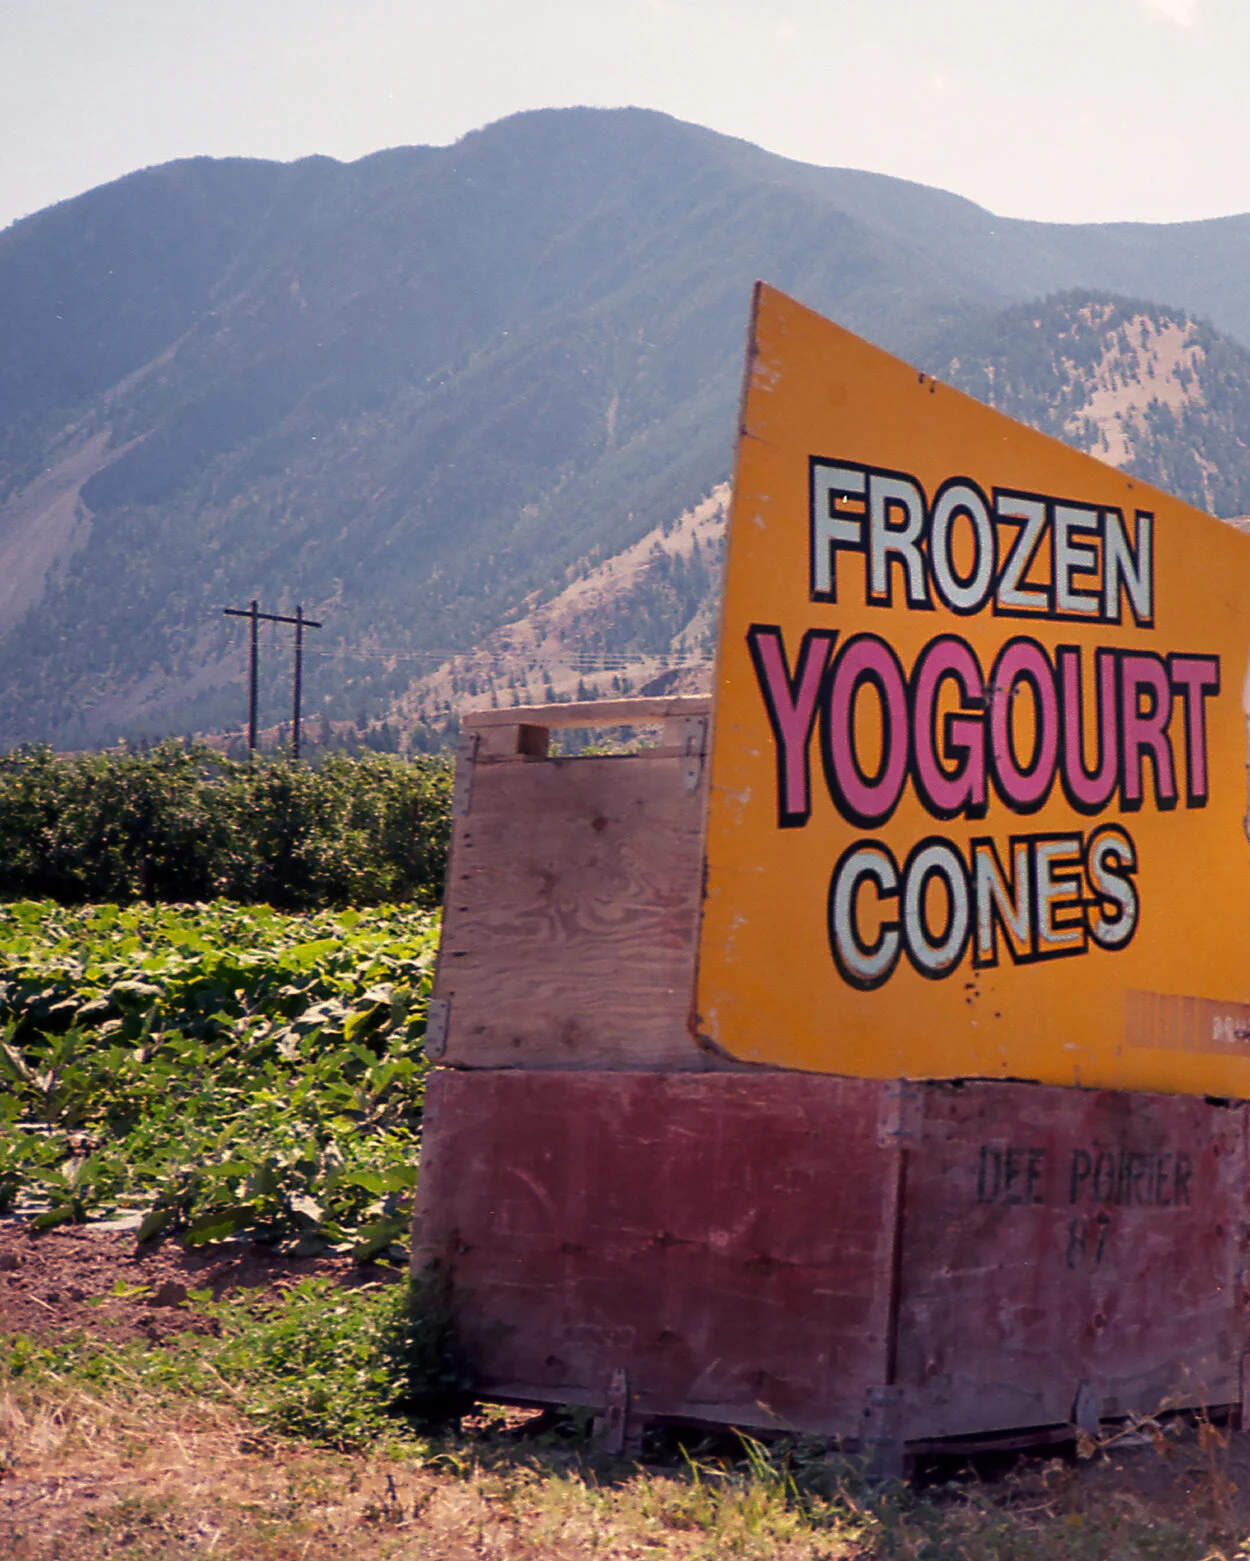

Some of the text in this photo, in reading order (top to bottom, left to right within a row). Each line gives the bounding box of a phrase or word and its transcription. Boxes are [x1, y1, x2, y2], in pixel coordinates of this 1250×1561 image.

[808, 455, 1155, 629] FROZEN
[747, 623, 1220, 828] YOGOURT
[827, 822, 1138, 991] CONES
